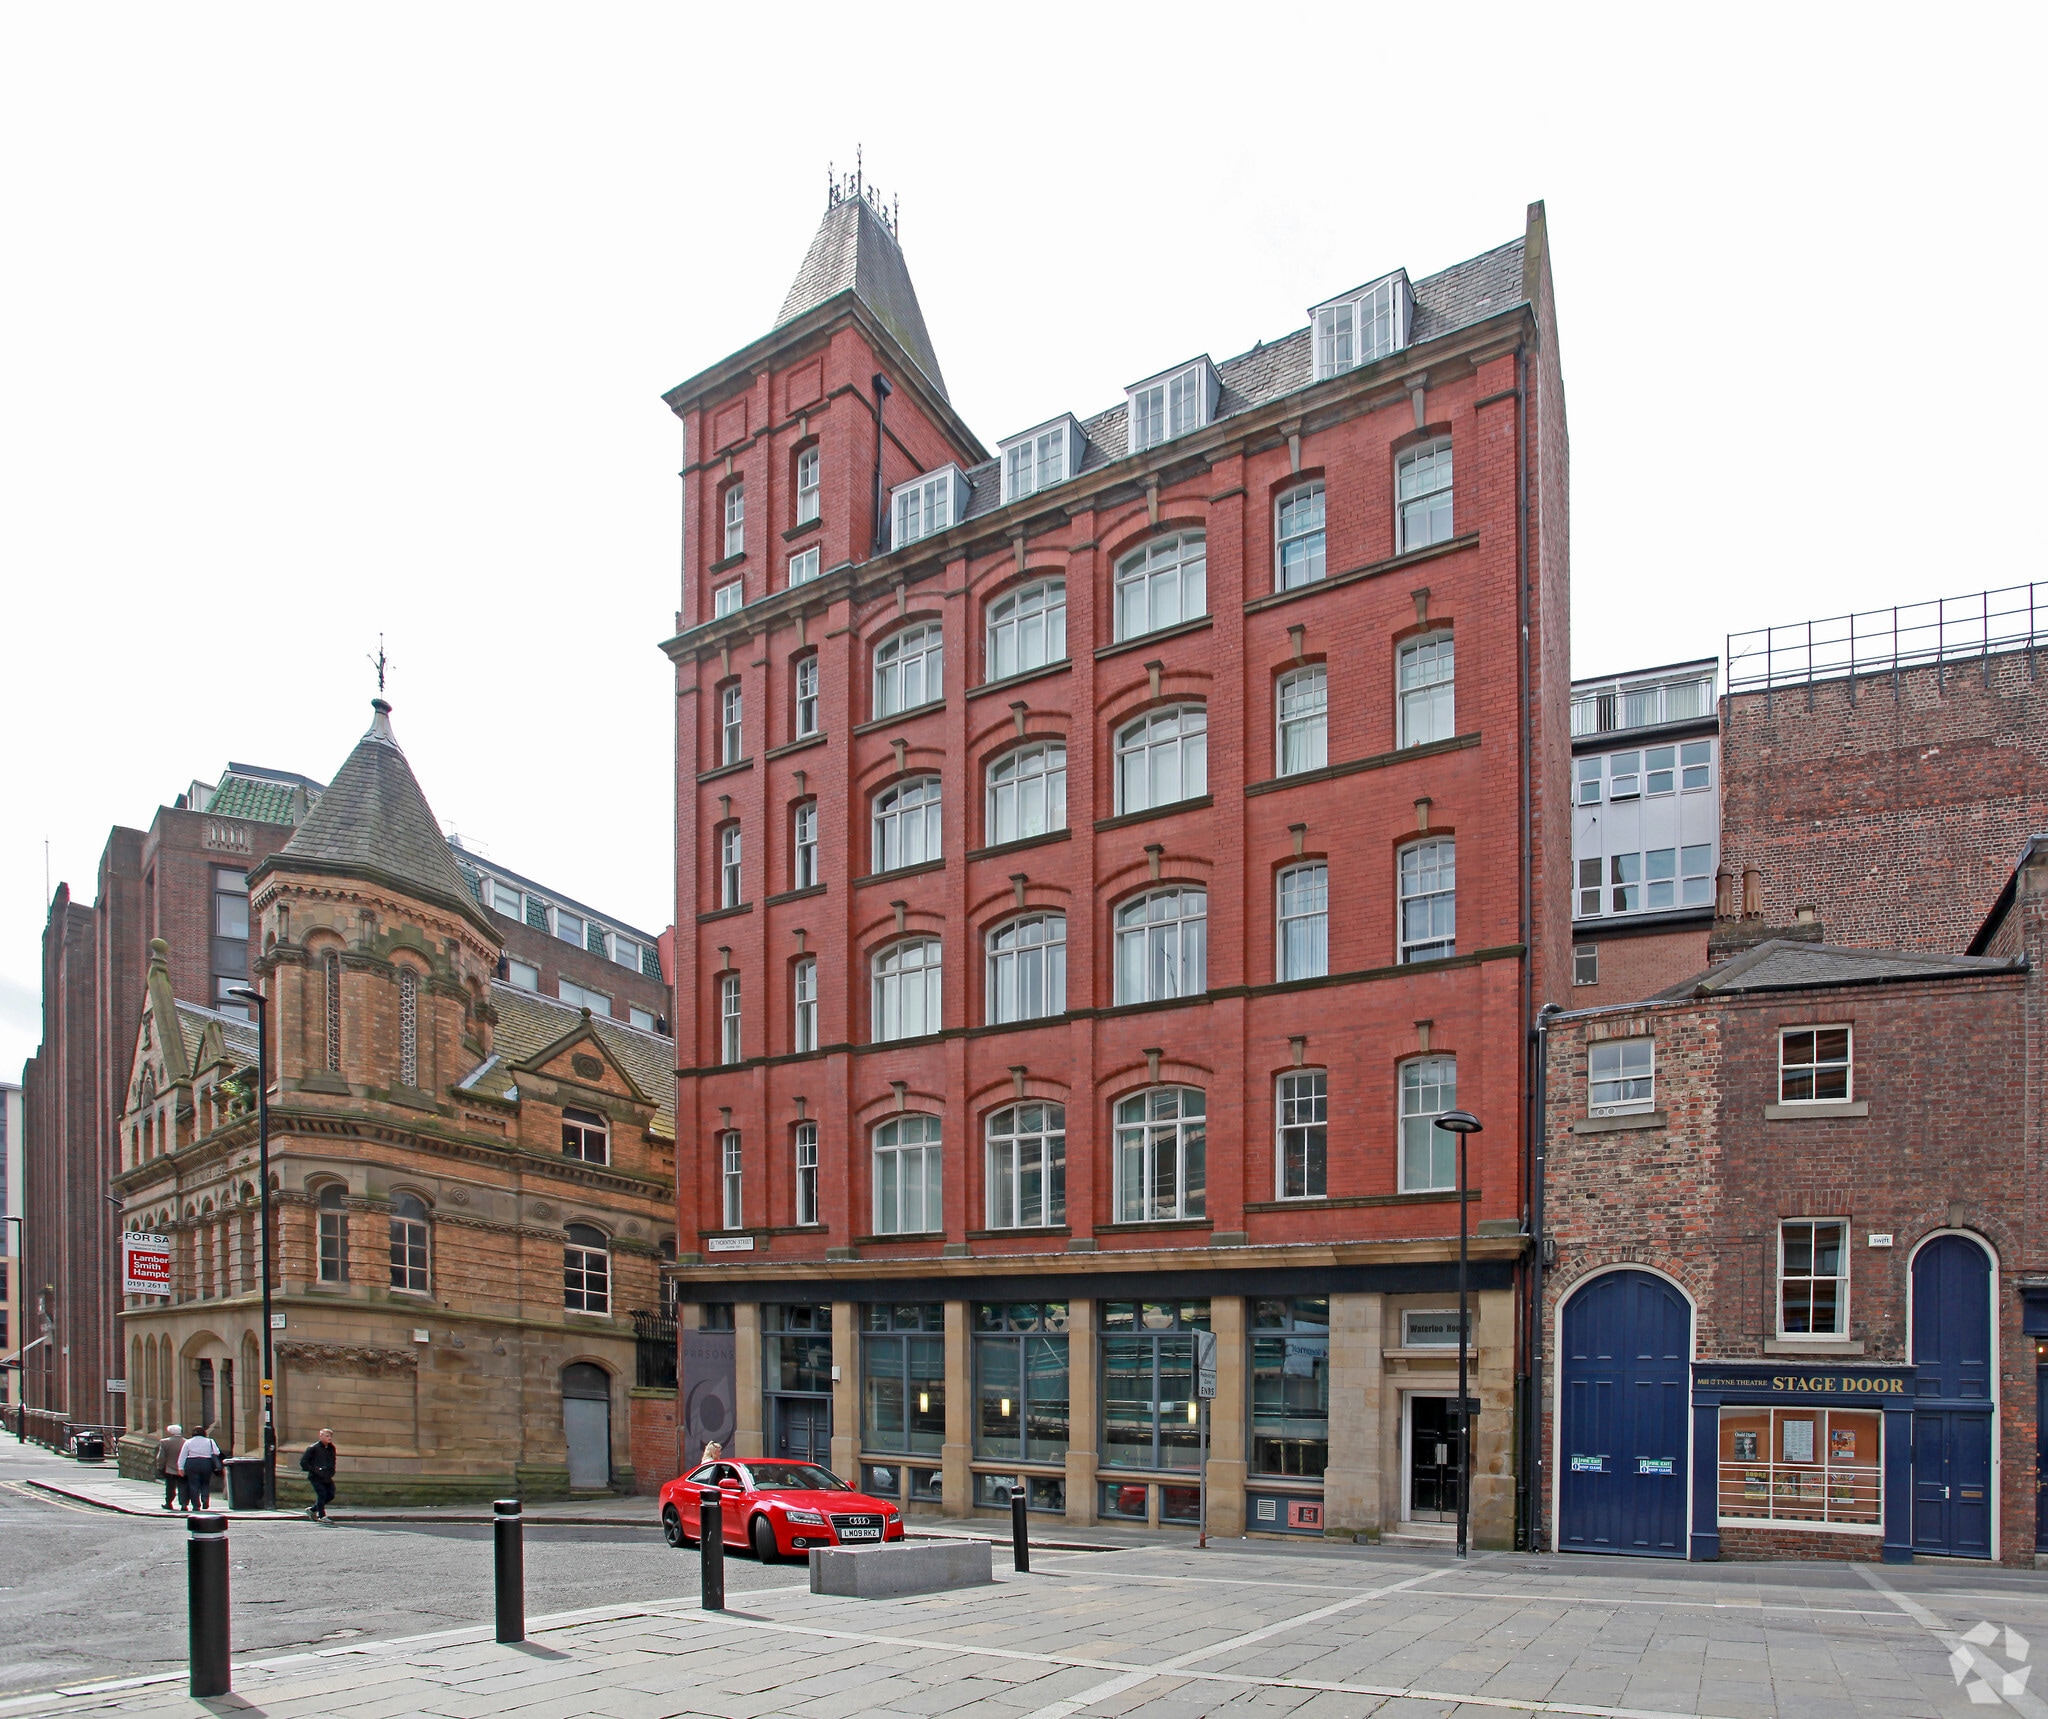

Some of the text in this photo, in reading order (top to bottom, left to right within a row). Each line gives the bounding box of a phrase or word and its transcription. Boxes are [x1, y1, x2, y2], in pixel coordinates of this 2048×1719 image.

[125, 1232, 170, 1243] FOR SA
[1873, 1236, 1889, 1244] swift
[133, 1254, 169, 1264] Lamber
[134, 1261, 161, 1270] Smith
[133, 1269, 170, 1278] Hampto
[1410, 1324, 1470, 1333] Waterloo Houe
[1772, 1376, 1837, 1391] STAGE
[1842, 1378, 1904, 1393] DOOR
[1201, 1386, 1215, 1396] ENDS
